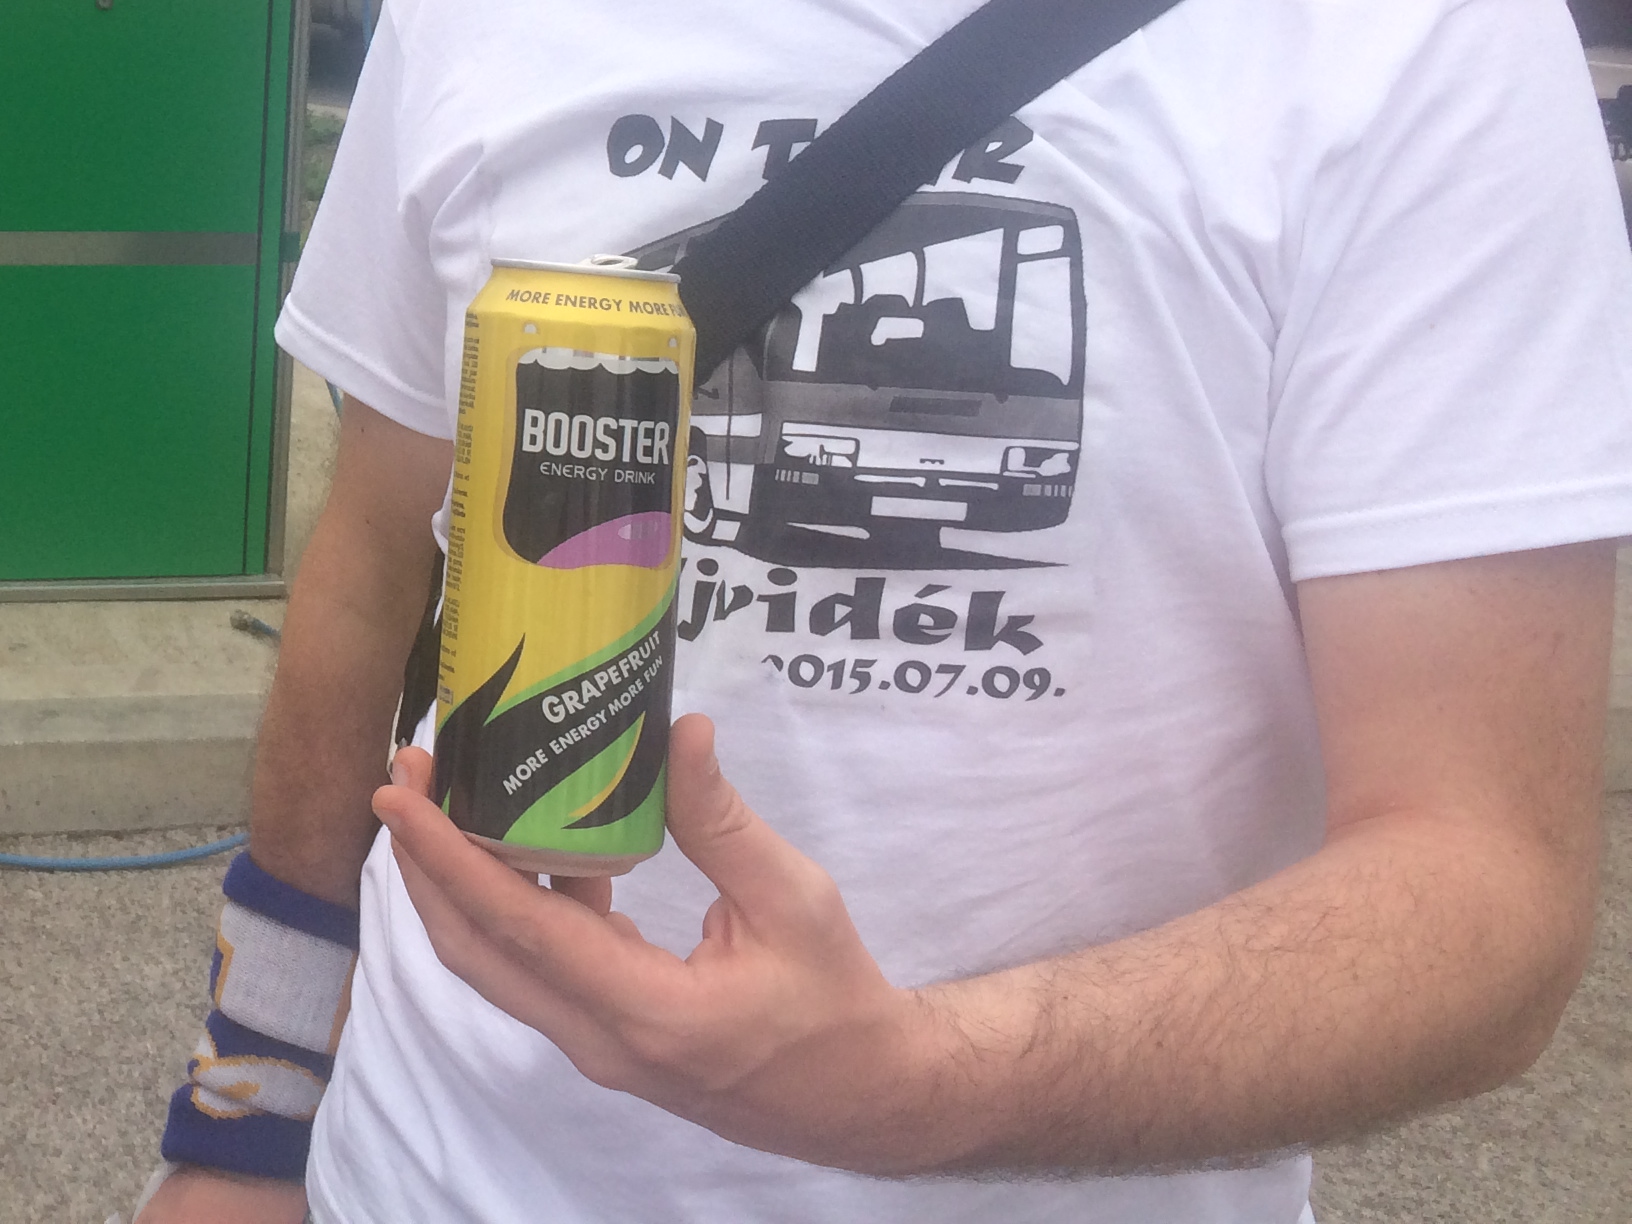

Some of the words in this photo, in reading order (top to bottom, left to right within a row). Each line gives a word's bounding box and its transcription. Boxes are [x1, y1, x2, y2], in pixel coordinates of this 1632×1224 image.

[606, 113, 724, 183] ON
[751, 113, 1035, 185] TR
[505, 288, 551, 305] MORE
[554, 292, 623, 313] ENERGY
[628, 300, 670, 317] MORE
[521, 407, 671, 466] BOOSTER
[539, 461, 609, 482] ENERGY
[614, 469, 656, 485] DRINK
[677, 556, 1044, 656] jvidék
[541, 631, 662, 725] GRAPEFRUIT
[502, 748, 549, 796] MORE
[548, 708, 609, 755] ENERGY
[609, 678, 645, 717] MORE
[646, 655, 664, 684] FUN
